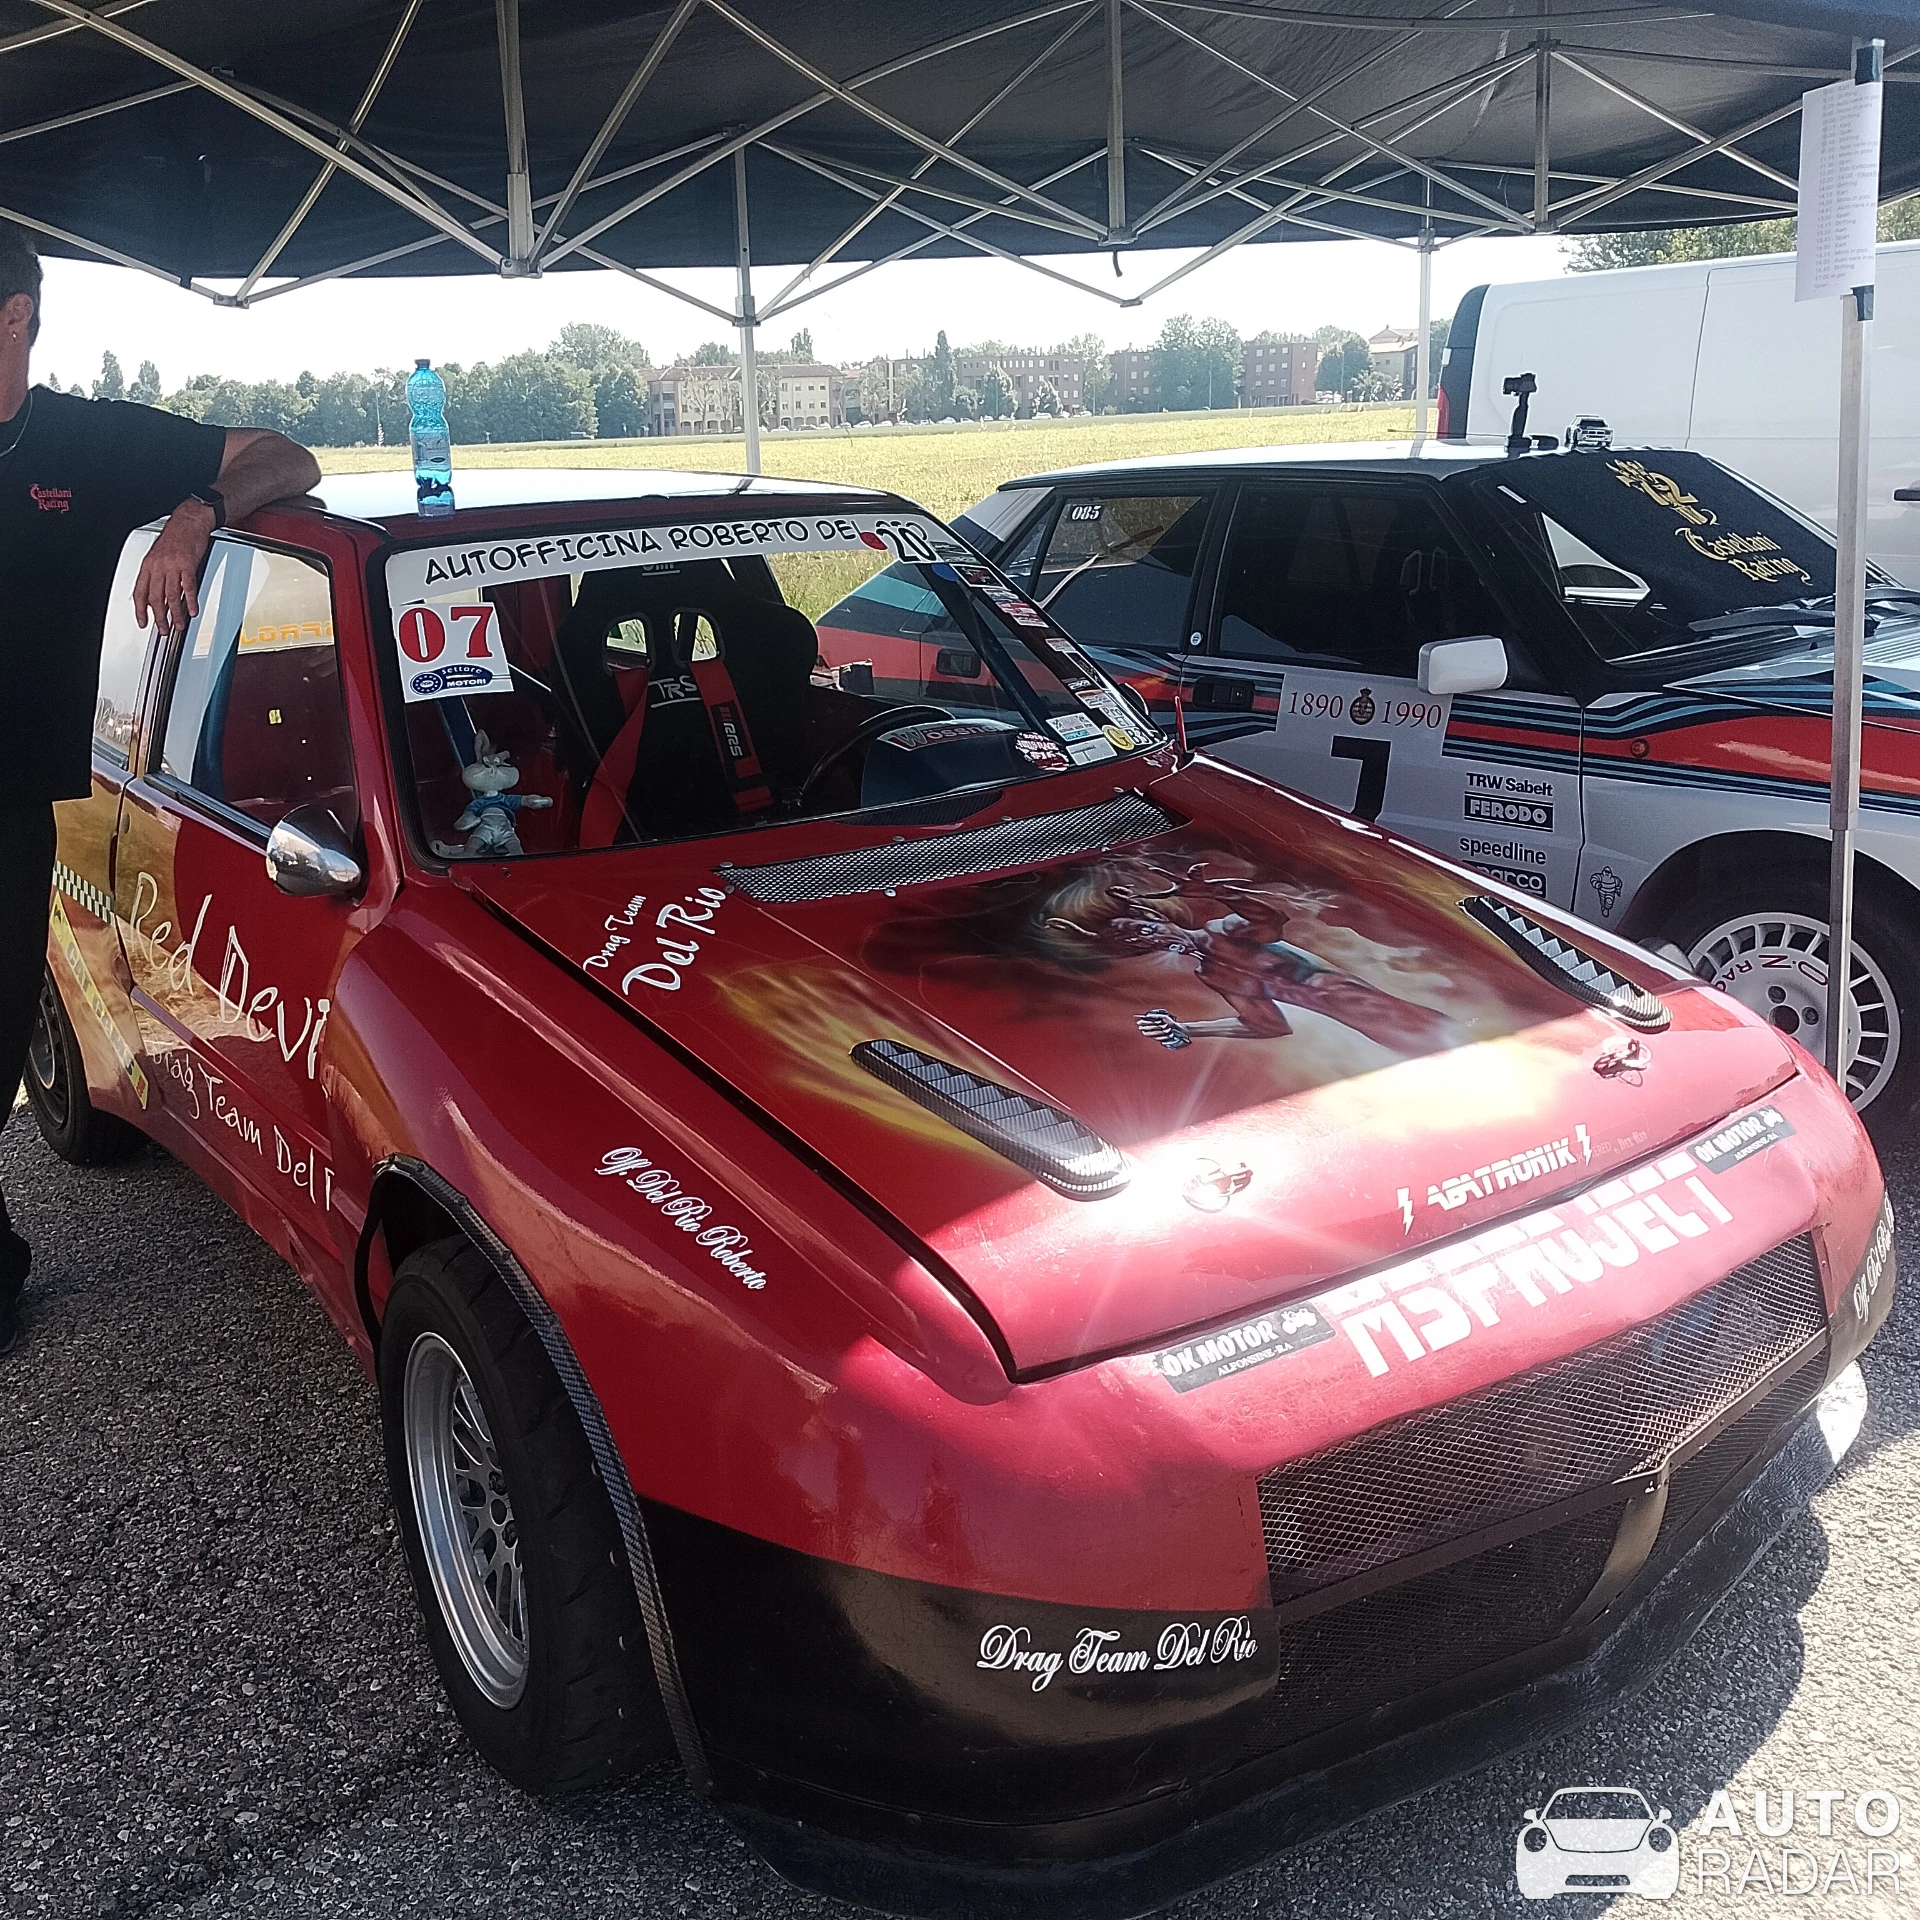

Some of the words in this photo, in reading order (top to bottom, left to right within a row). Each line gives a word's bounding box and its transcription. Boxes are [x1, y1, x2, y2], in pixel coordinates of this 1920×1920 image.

[1071, 505, 1102, 521] 085
[425, 530, 662, 585] AUTOFFICINA
[667, 520, 810, 551] ROBERTO
[398, 606, 494, 663] 07
[446, 678, 487, 688] MOTORI
[648, 675, 698, 700] TRS
[1288, 691, 1344, 718] 1890
[1381, 701, 1443, 728] 1990
[1330, 734, 1392, 824] 7
[1465, 771, 1504, 790] TRW
[1505, 777, 1554, 797] Sabelt
[1469, 798, 1547, 824] FERODO
[1459, 837, 1547, 865] speedline
[655, 887, 727, 935] Rio
[582, 934, 631, 971] Drag
[621, 936, 700, 996] Del
[1693, 1140, 1723, 1163] OK
[1712, 1116, 1767, 1154] MOTOR
[695, 1225, 767, 1290] Roberto
[1161, 1346, 1202, 1377] OK
[1195, 1319, 1280, 1368] MOTOR
[976, 1623, 1064, 1693] Drag
[1068, 1626, 1151, 1674] Team
[1153, 1621, 1211, 1671] Del
[1210, 1614, 1259, 1664] Rio
